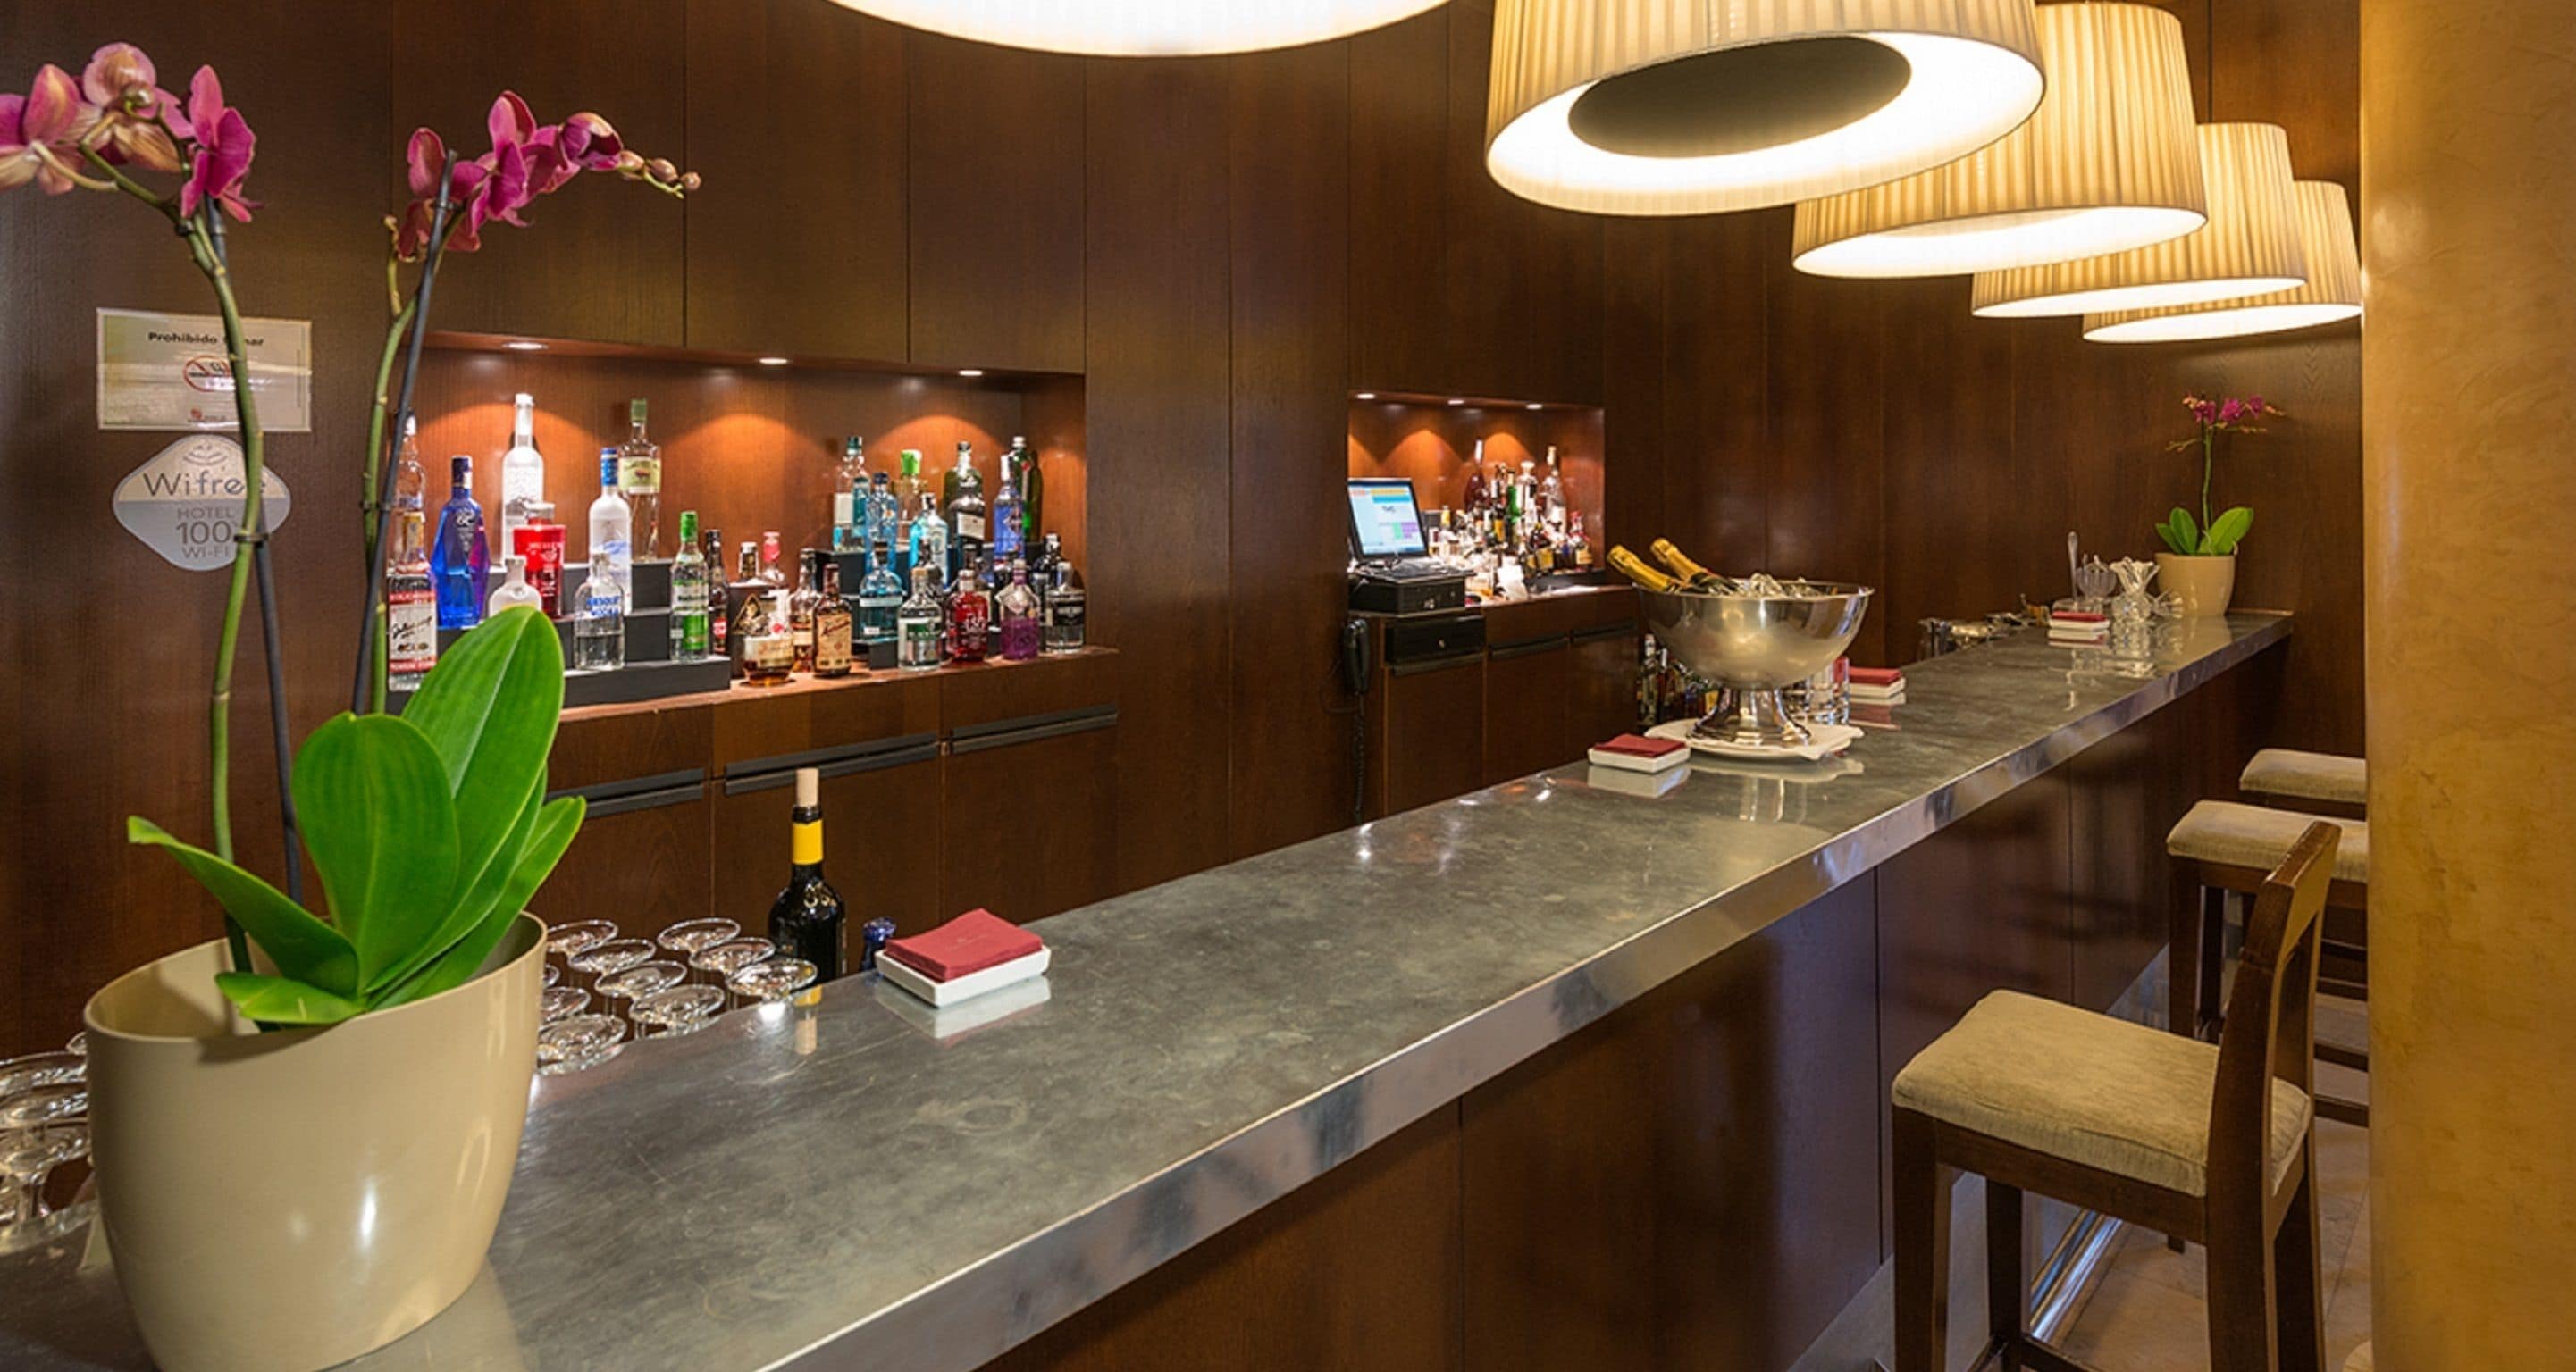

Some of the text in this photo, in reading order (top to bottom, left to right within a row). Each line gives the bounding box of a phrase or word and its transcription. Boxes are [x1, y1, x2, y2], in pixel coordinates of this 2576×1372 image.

[148, 331, 218, 344] Prohibido
[143, 471, 265, 497] Wifre
[178, 506, 236, 520] HOTEL
[181, 546, 230, 558] WI-FI
